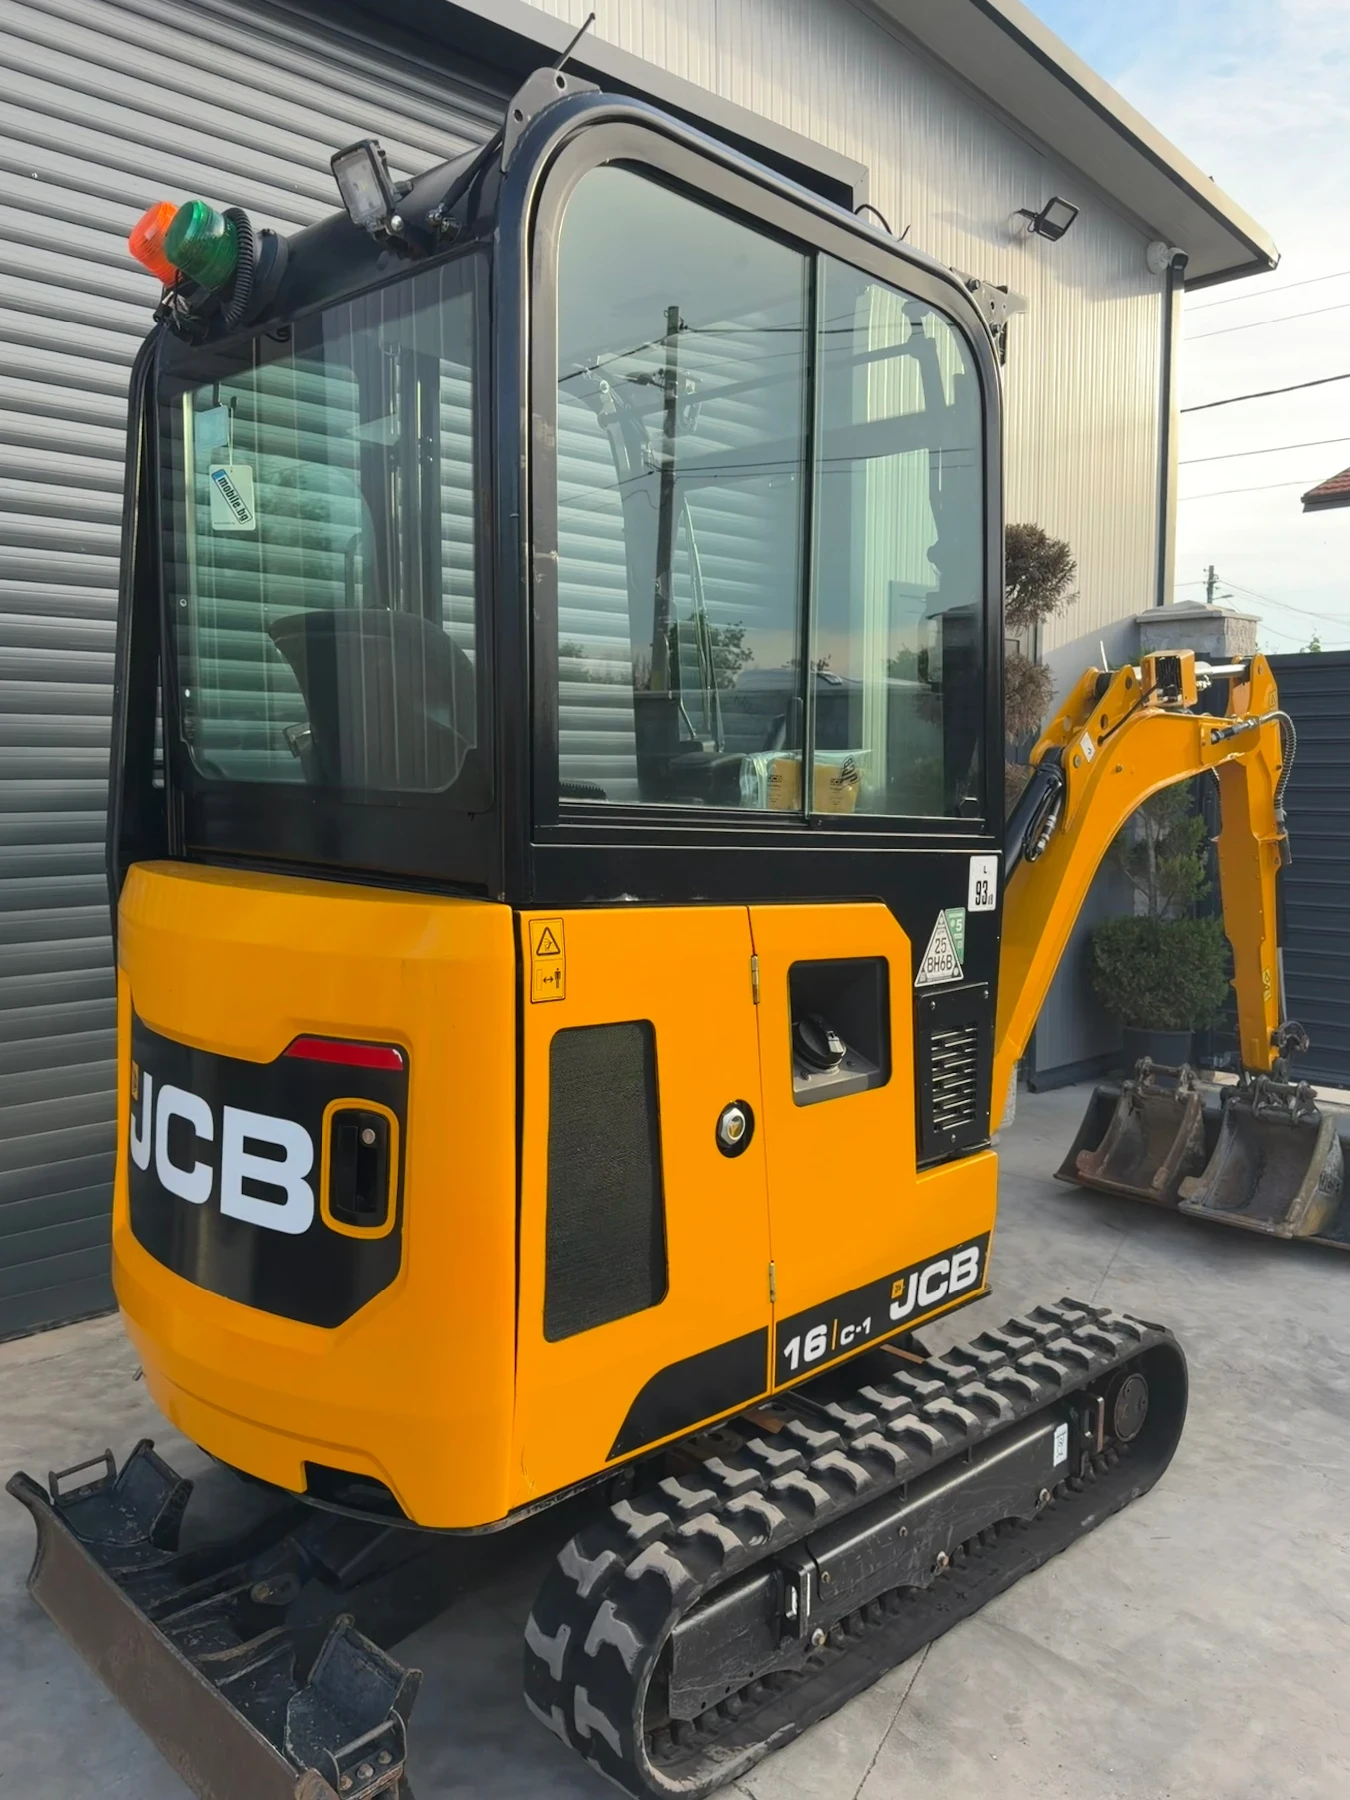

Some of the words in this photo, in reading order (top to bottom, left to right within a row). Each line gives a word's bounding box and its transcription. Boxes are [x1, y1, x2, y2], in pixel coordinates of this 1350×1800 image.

[217, 477, 250, 522] mobile.bg
[926, 954, 953, 974] BH6B
[934, 937, 947, 954] 25
[130, 1071, 315, 1235] JCB
[889, 1246, 980, 1321] JCB
[783, 1324, 828, 1371] 16
